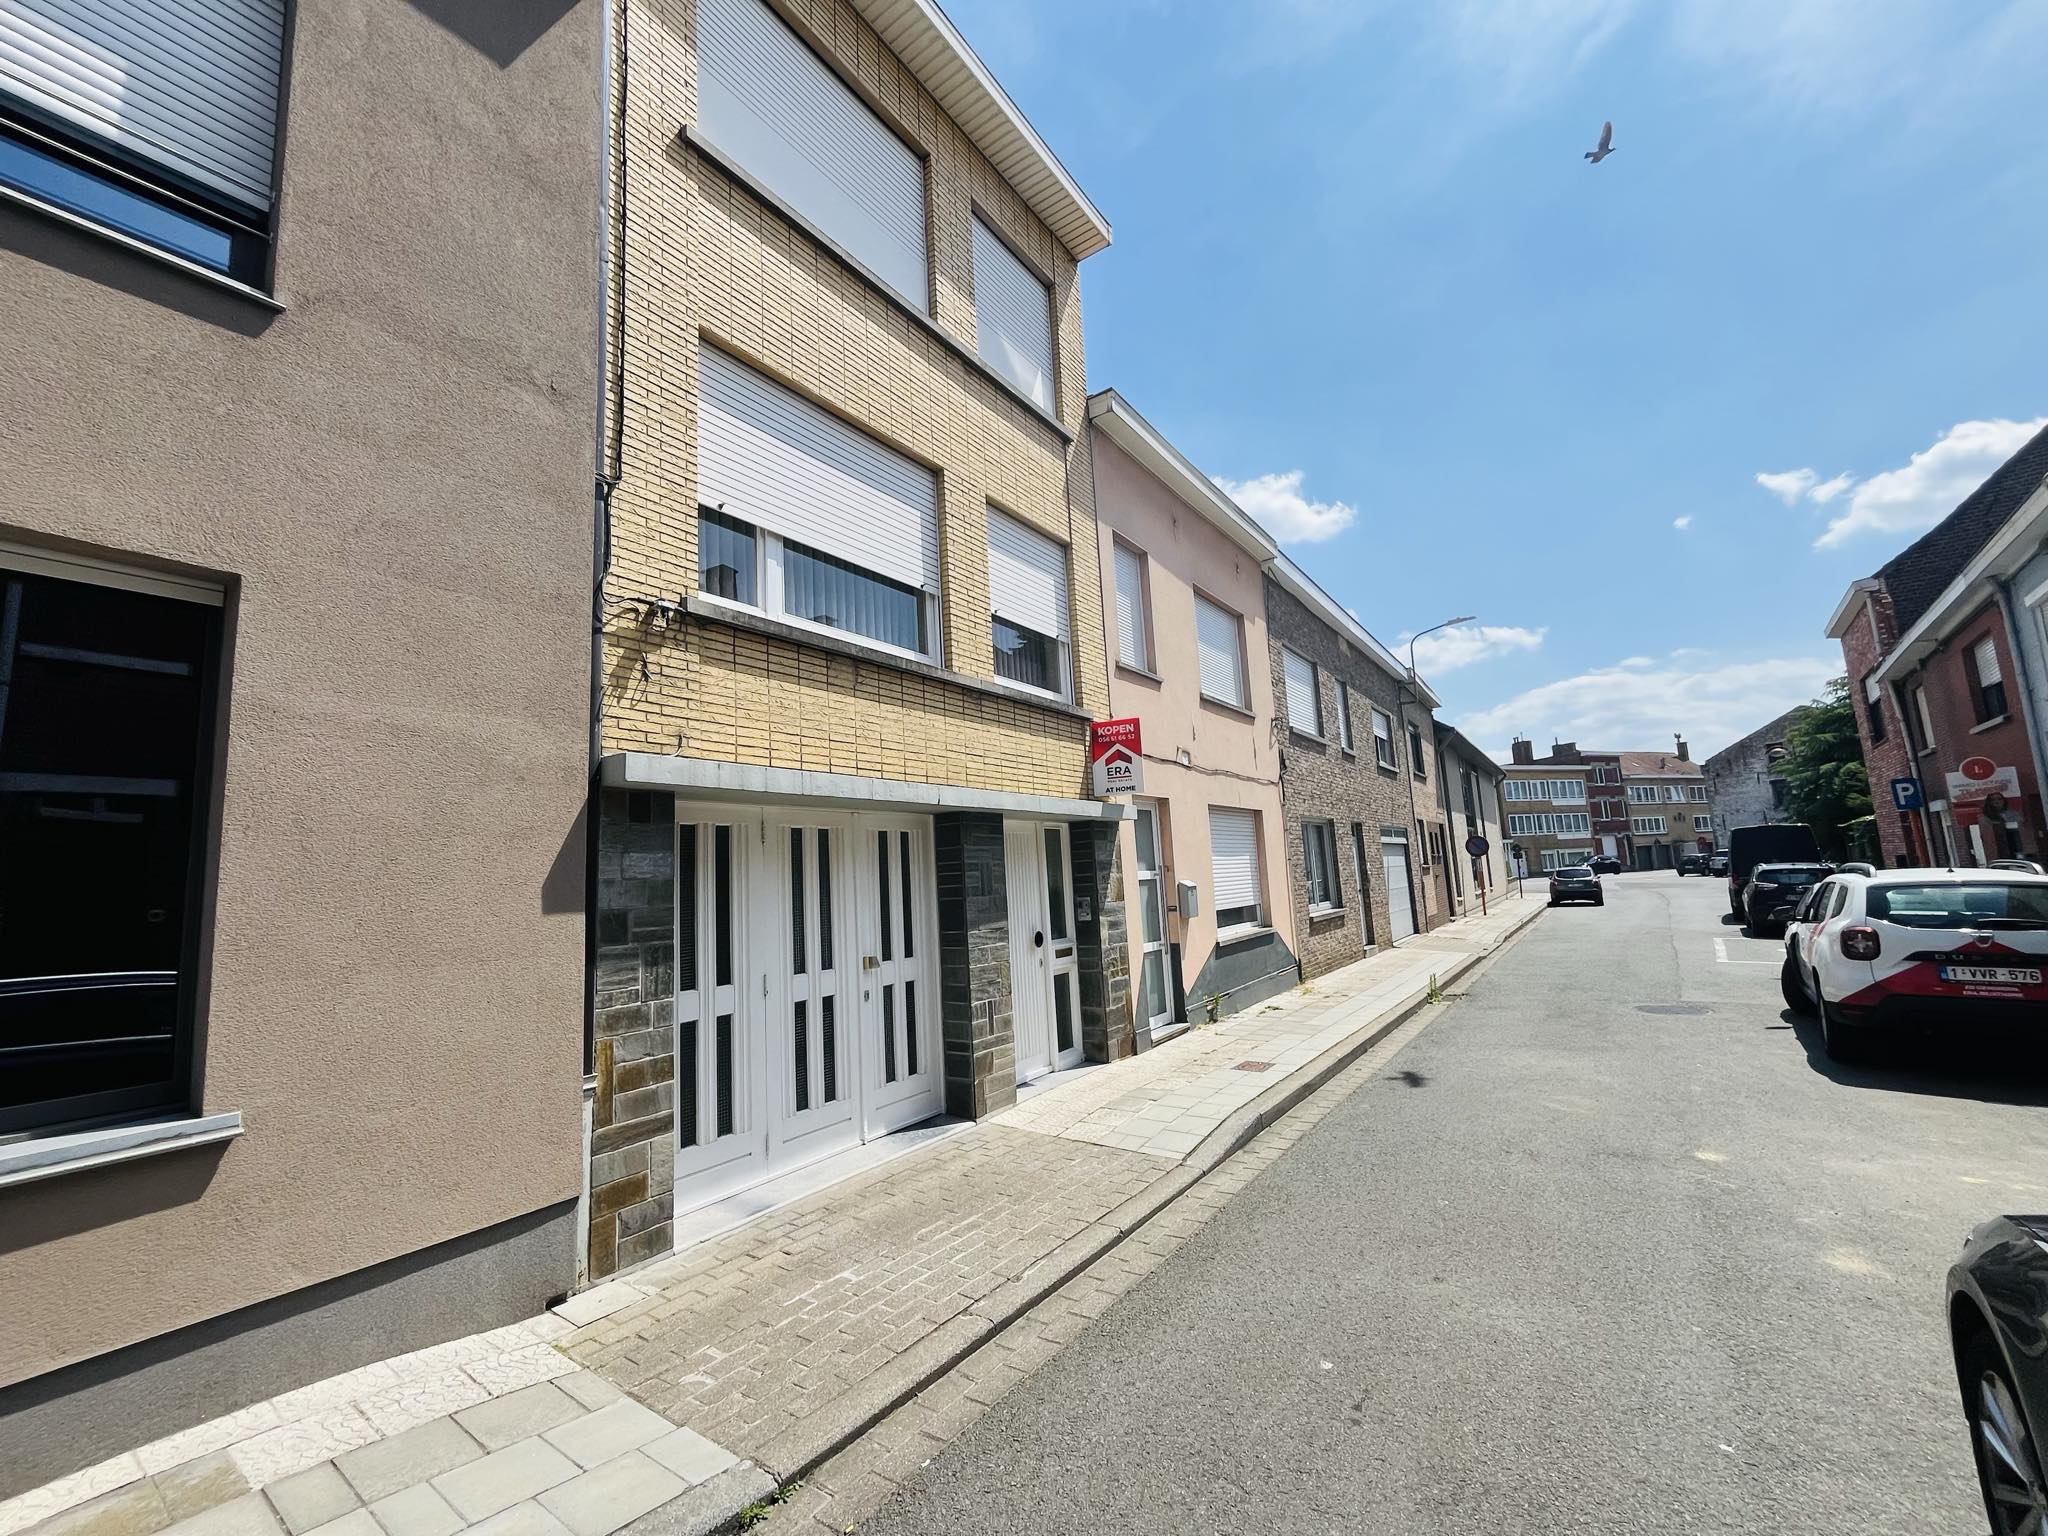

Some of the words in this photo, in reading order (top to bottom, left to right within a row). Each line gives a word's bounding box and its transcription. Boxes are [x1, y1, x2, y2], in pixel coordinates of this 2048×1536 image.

[1098, 724, 1134, 735] KOPEN
[1107, 766, 1131, 776] ERA
[1895, 783, 1914, 805] P
